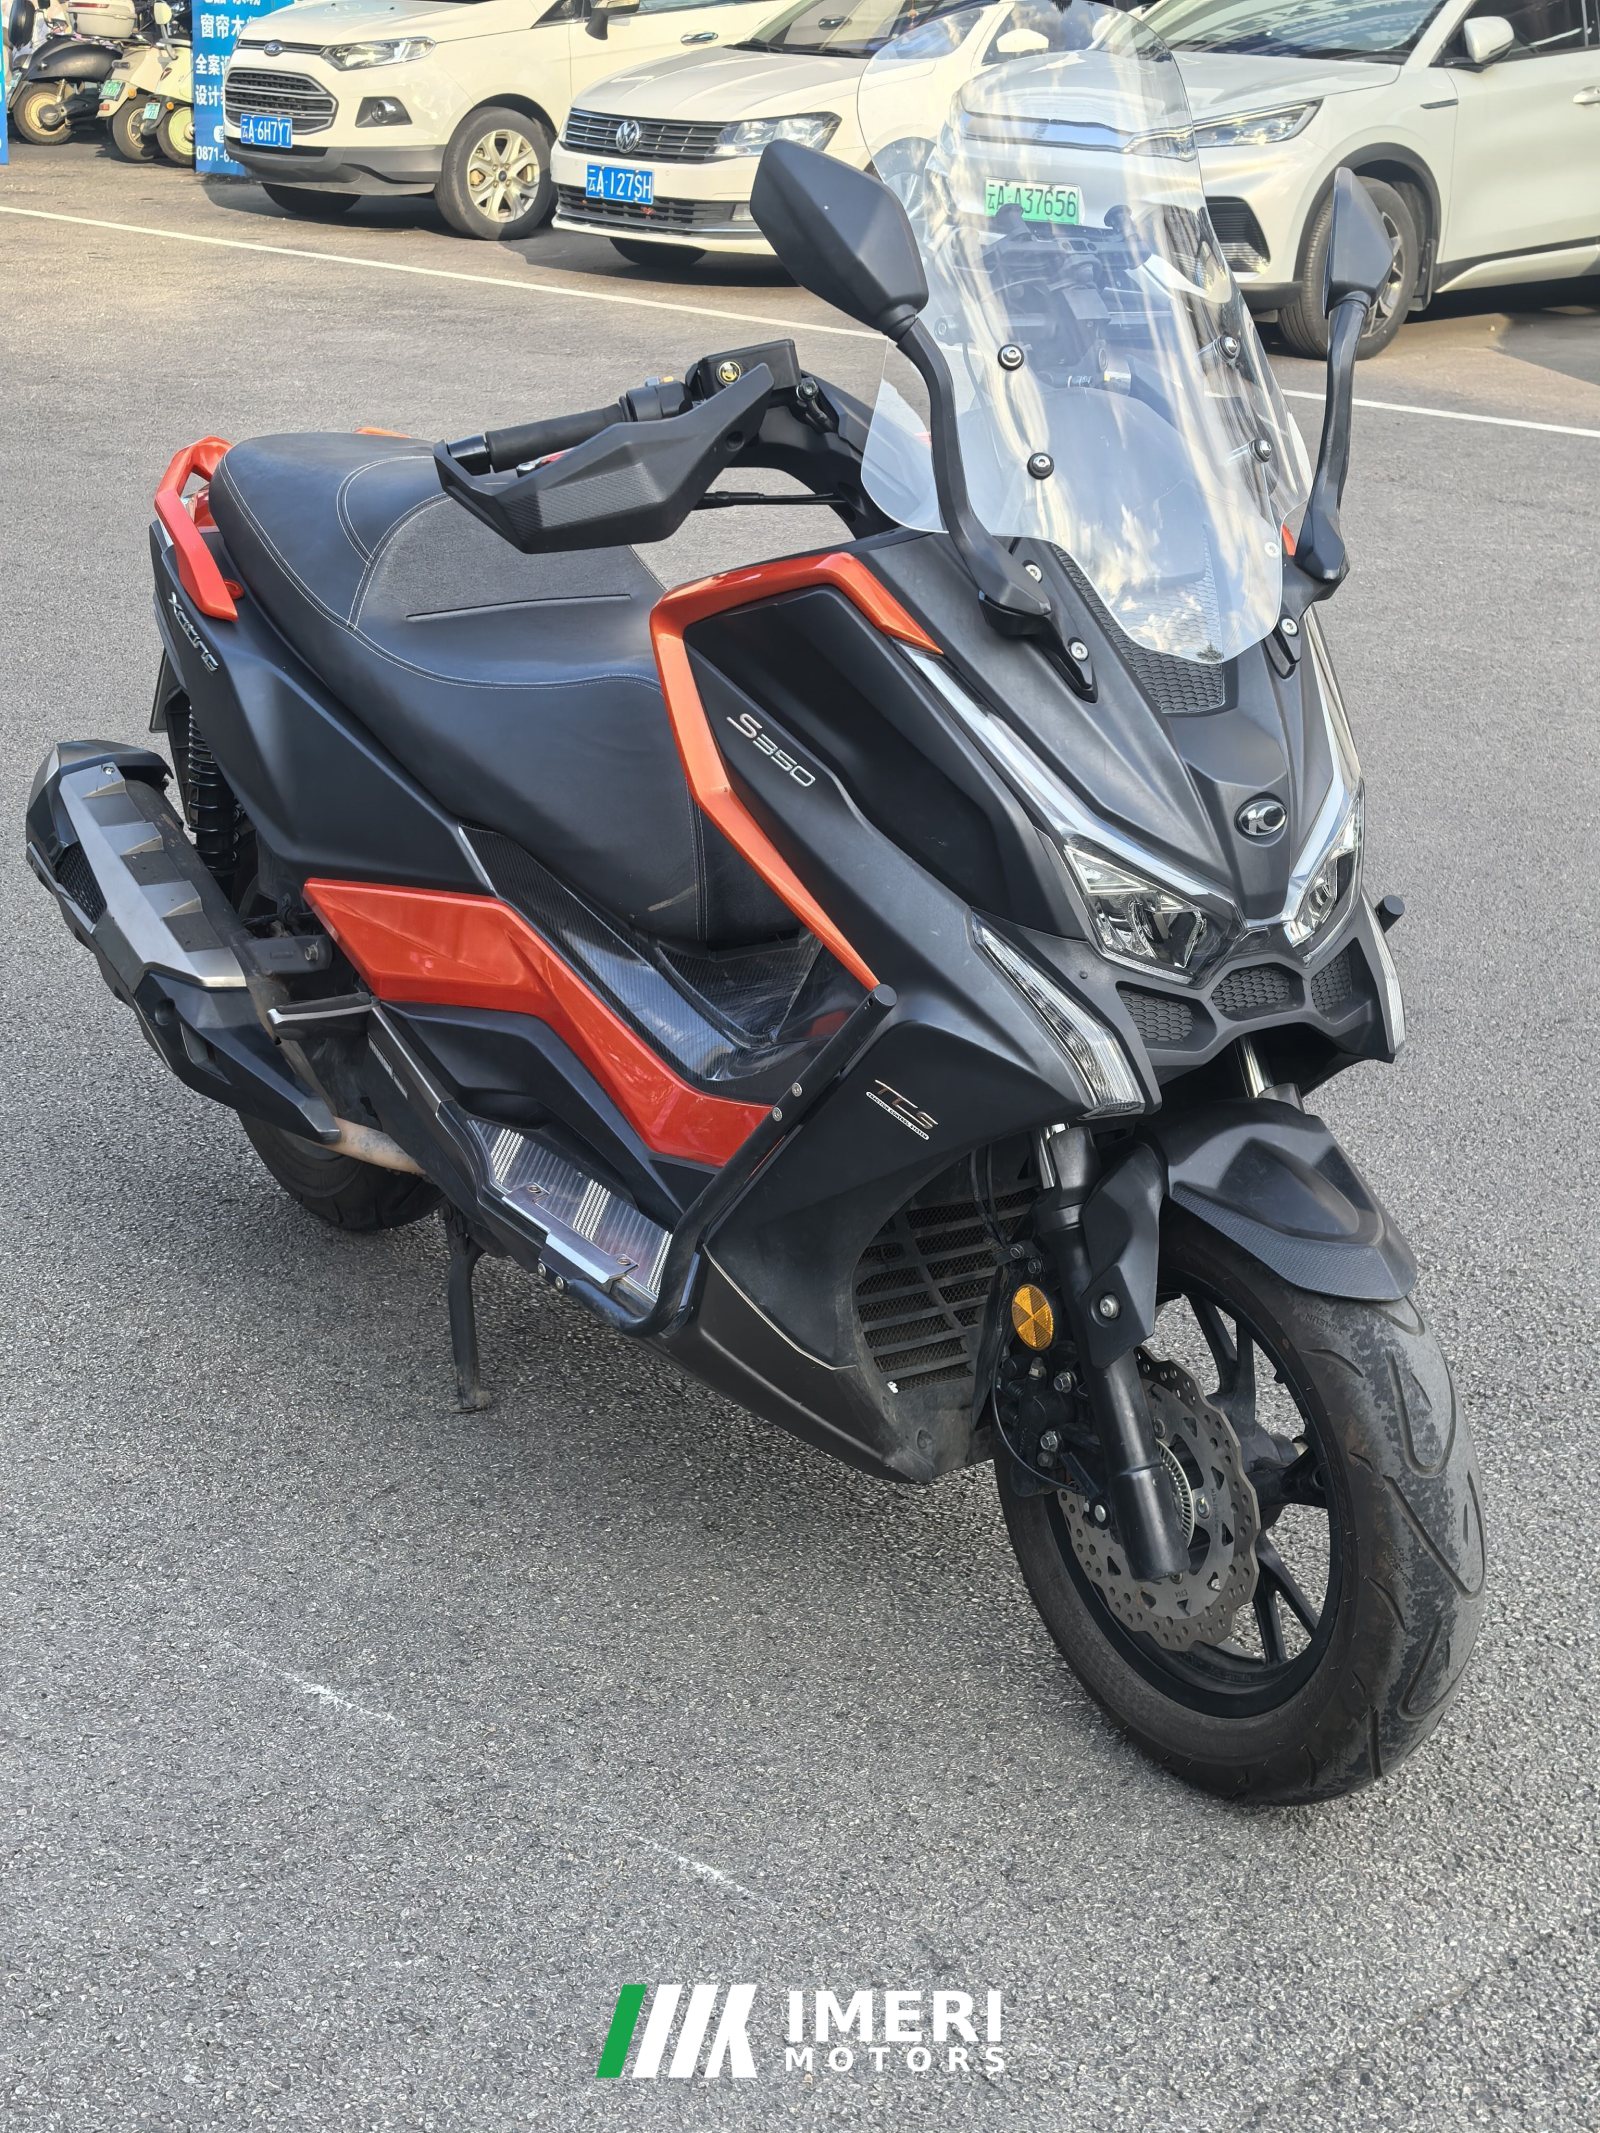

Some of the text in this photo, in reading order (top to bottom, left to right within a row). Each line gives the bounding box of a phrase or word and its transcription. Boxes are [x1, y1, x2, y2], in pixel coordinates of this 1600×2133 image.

[200, 13, 261, 39] 窗帘木
[194, 84, 224, 107] 设计
[196, 145, 240, 164] 0871-6
[726, 713, 816, 787] S350
[875, 1079, 939, 1130] TCS
